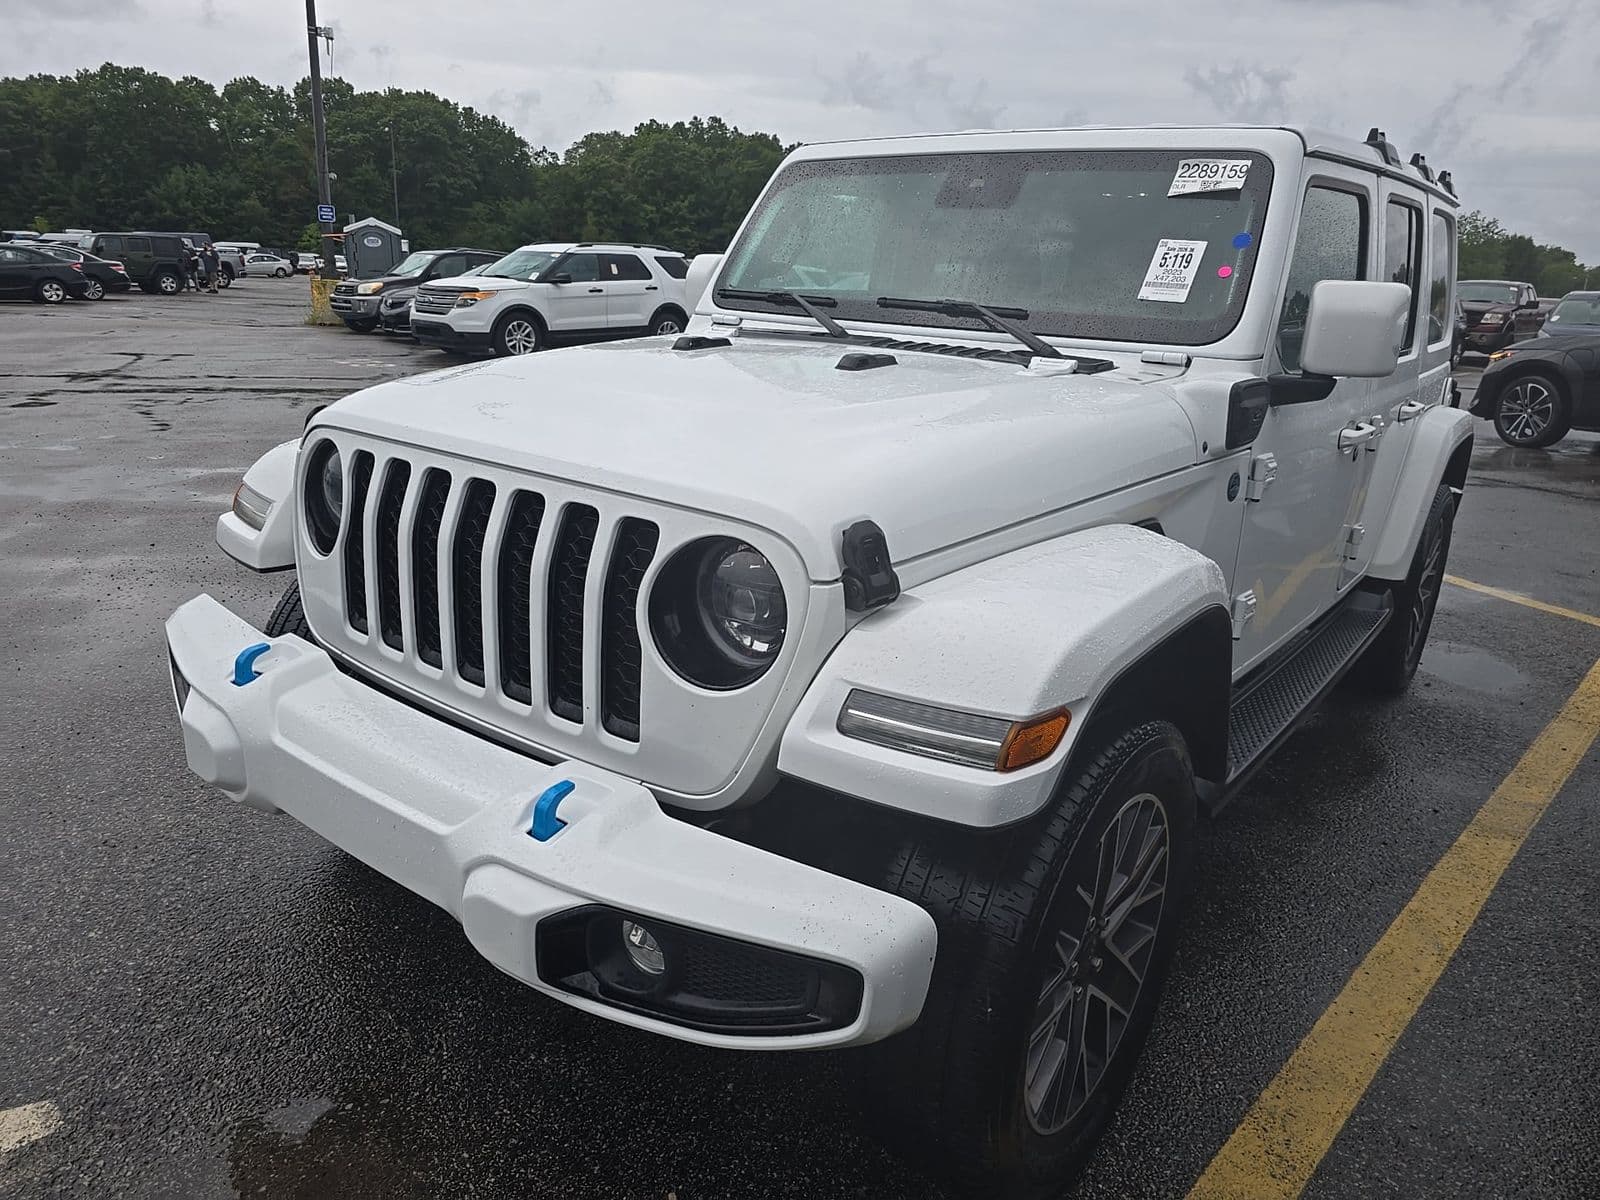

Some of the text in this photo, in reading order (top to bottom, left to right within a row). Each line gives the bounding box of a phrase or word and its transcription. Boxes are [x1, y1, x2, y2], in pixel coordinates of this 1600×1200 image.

[1178, 163, 1249, 179] 2289159
[1159, 252, 1193, 269] 5:119
[1162, 268, 1183, 276] 2023
